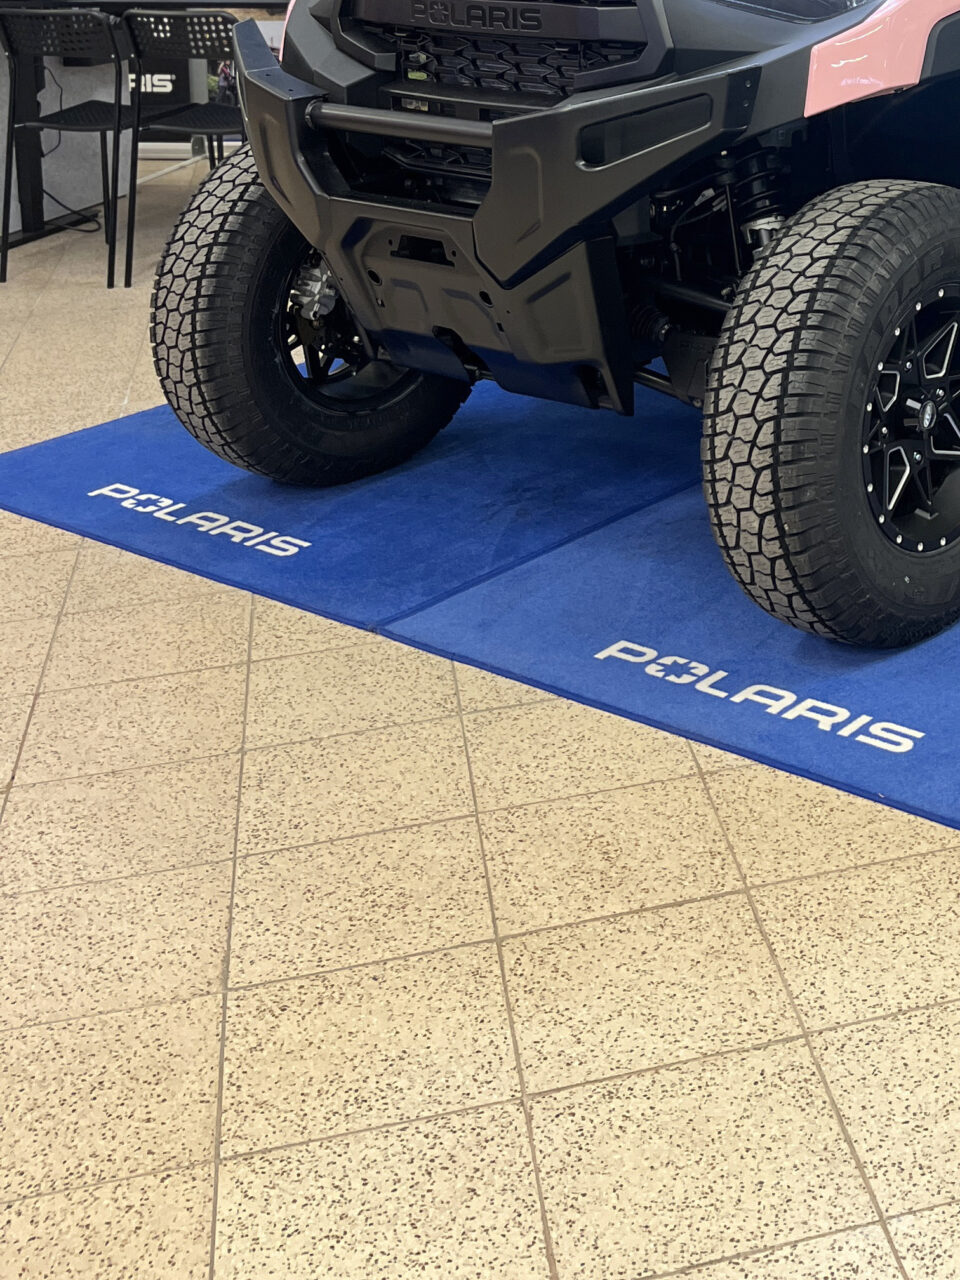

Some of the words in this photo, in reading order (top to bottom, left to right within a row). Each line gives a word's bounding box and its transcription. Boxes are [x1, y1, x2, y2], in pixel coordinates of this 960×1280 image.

[410, 1, 543, 32] POLARIS
[87, 483, 313, 557] POLARIS
[593, 640, 926, 753] POLARIS
